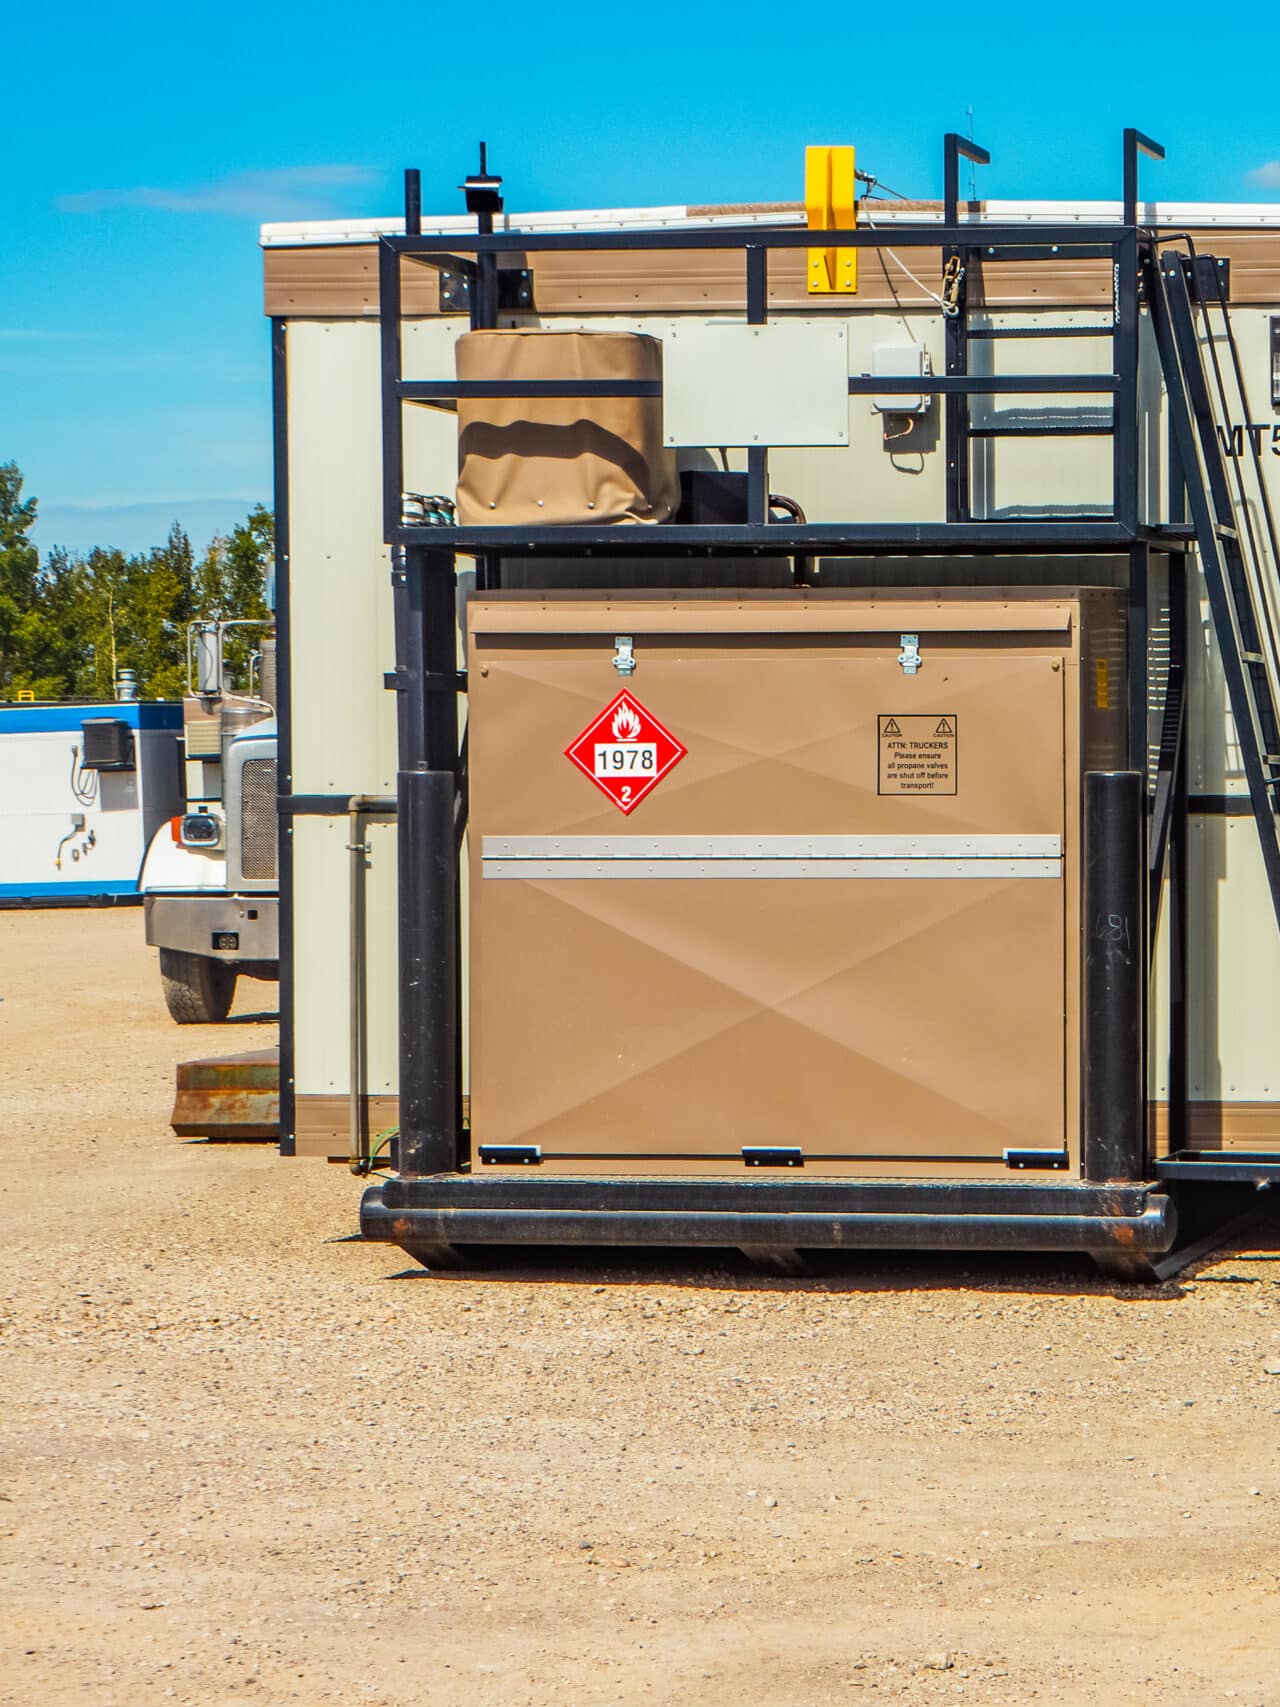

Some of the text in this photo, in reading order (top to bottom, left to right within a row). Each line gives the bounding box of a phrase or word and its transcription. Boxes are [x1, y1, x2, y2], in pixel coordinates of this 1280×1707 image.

[887, 741, 949, 749] ATTN: TRUCKERS
[598, 750, 653, 770] 1978
[897, 763, 926, 771] propane
[621, 786, 632, 802] 2
